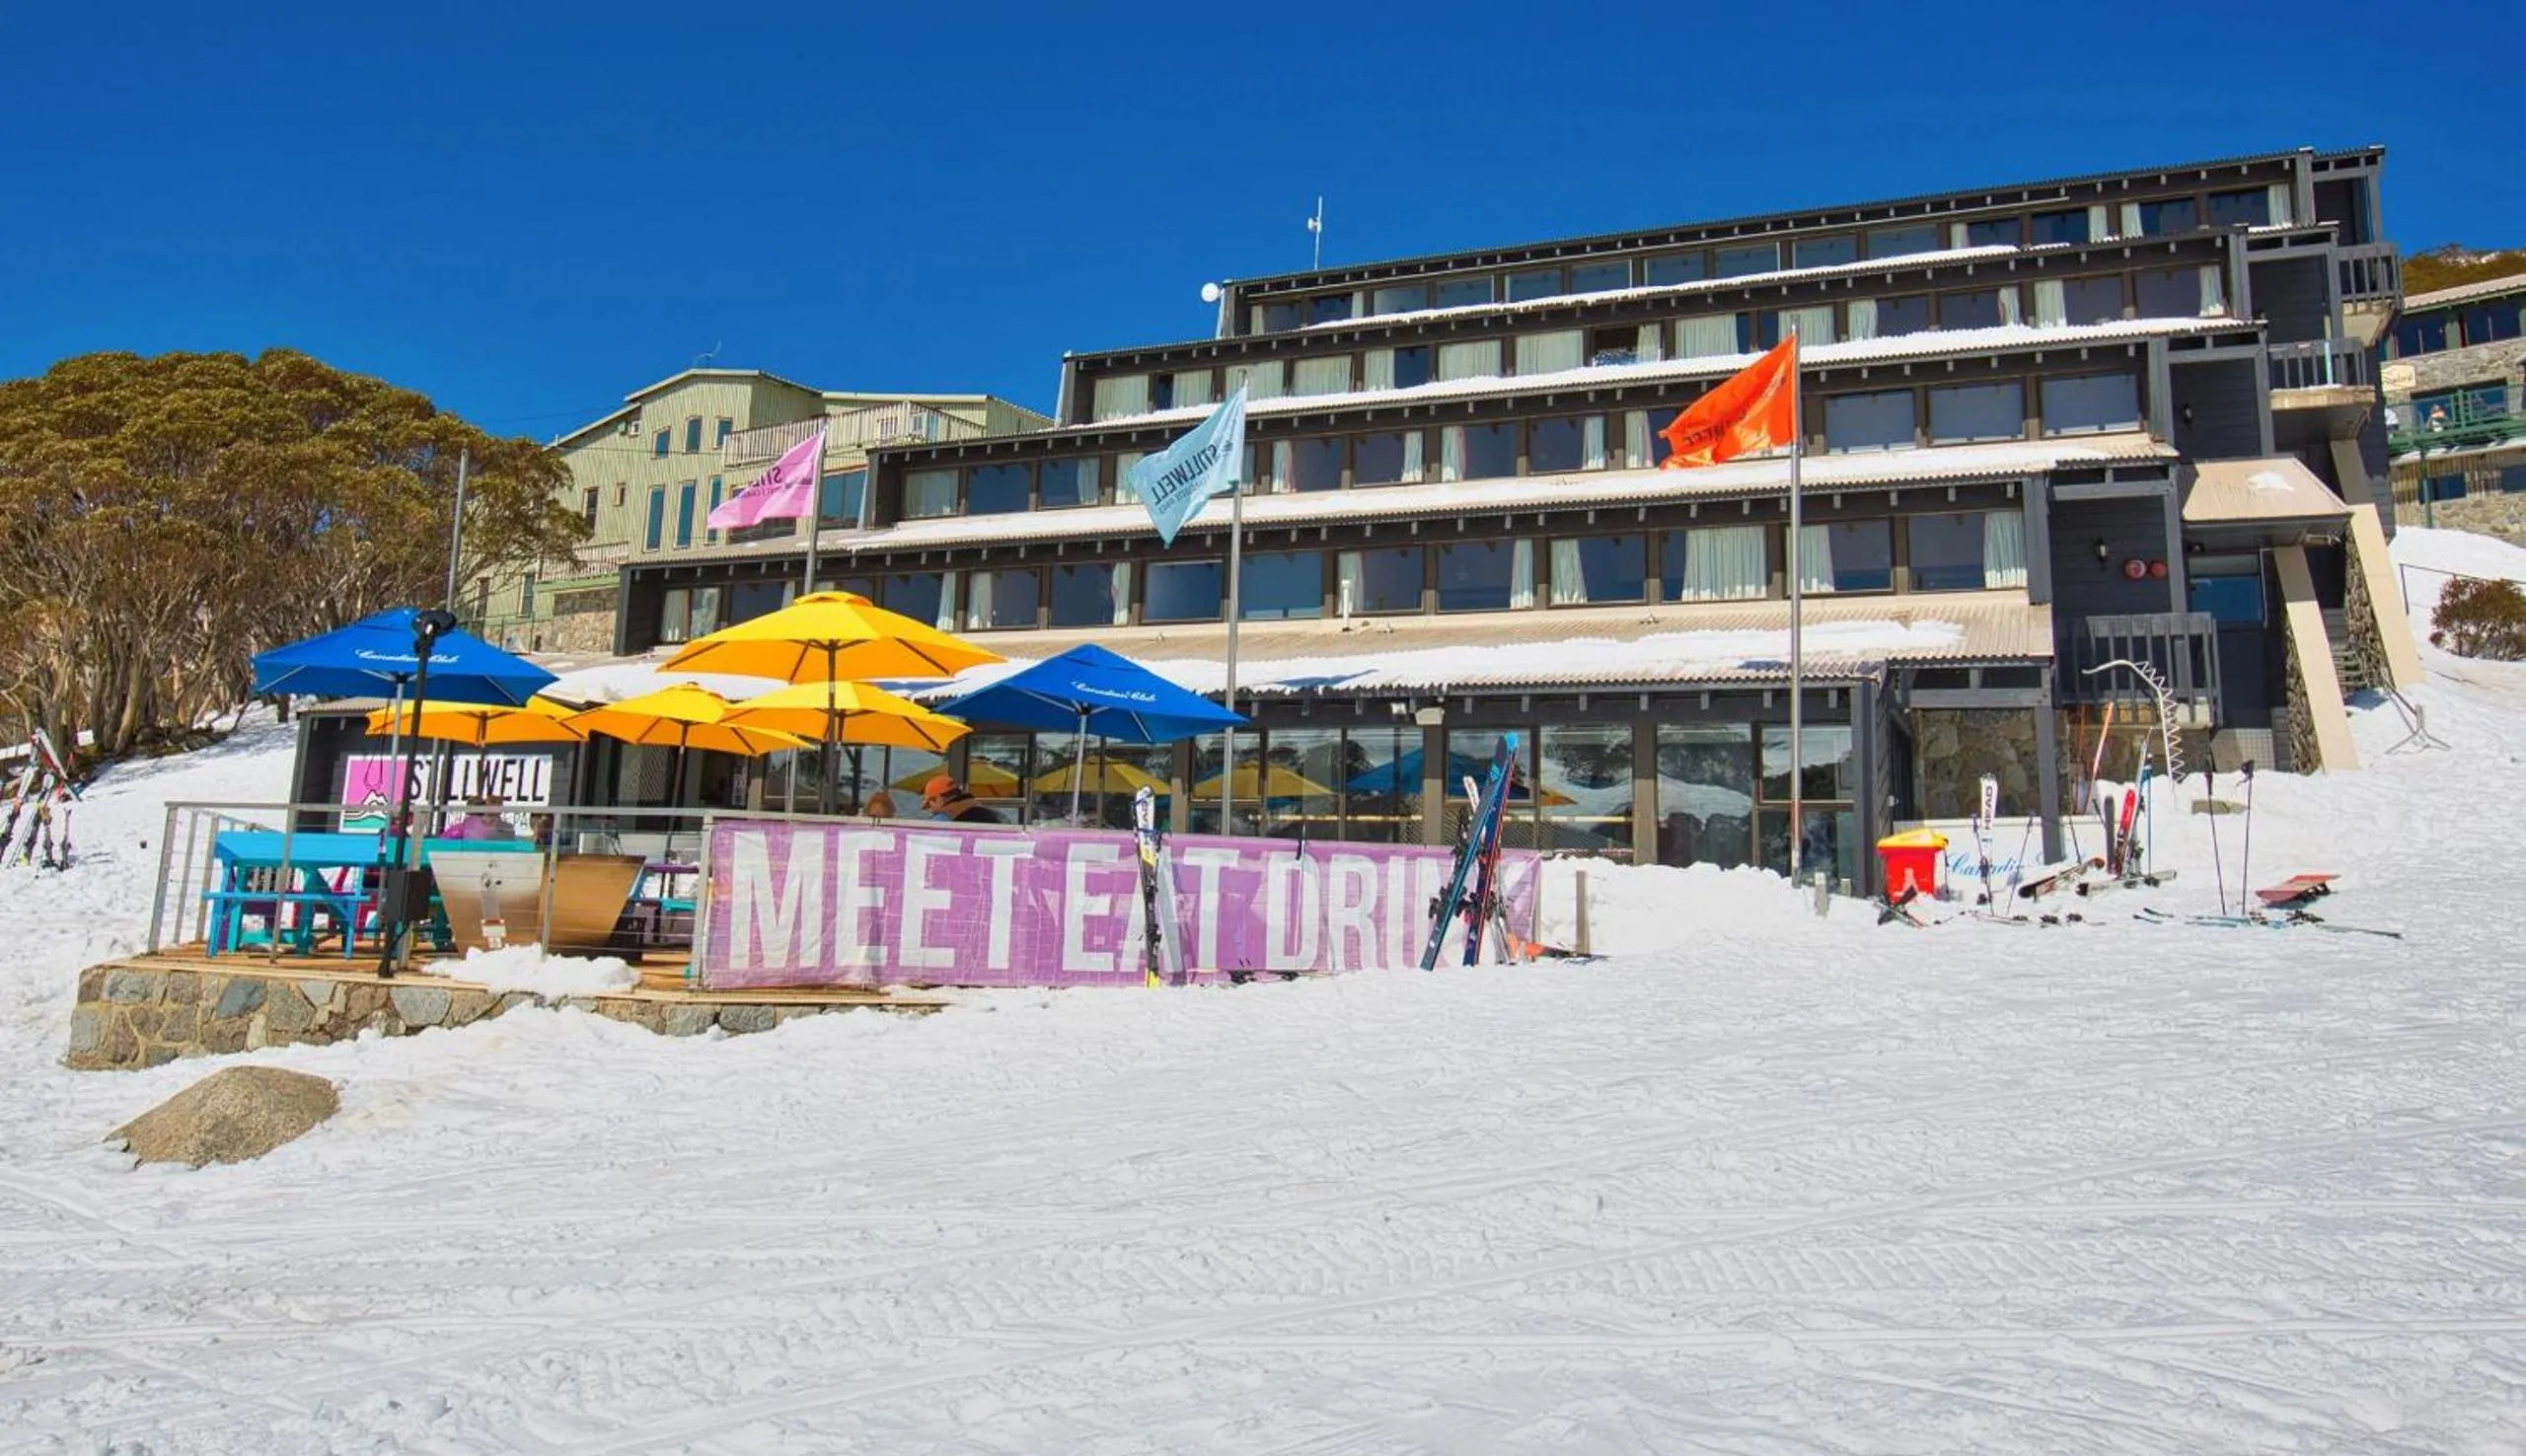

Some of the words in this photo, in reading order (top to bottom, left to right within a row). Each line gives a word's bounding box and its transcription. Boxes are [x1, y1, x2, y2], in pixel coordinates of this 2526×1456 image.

[1983, 785, 1993, 831] HEAD
[728, 830, 1036, 971] MEET
[1062, 842, 1240, 973] EAT
